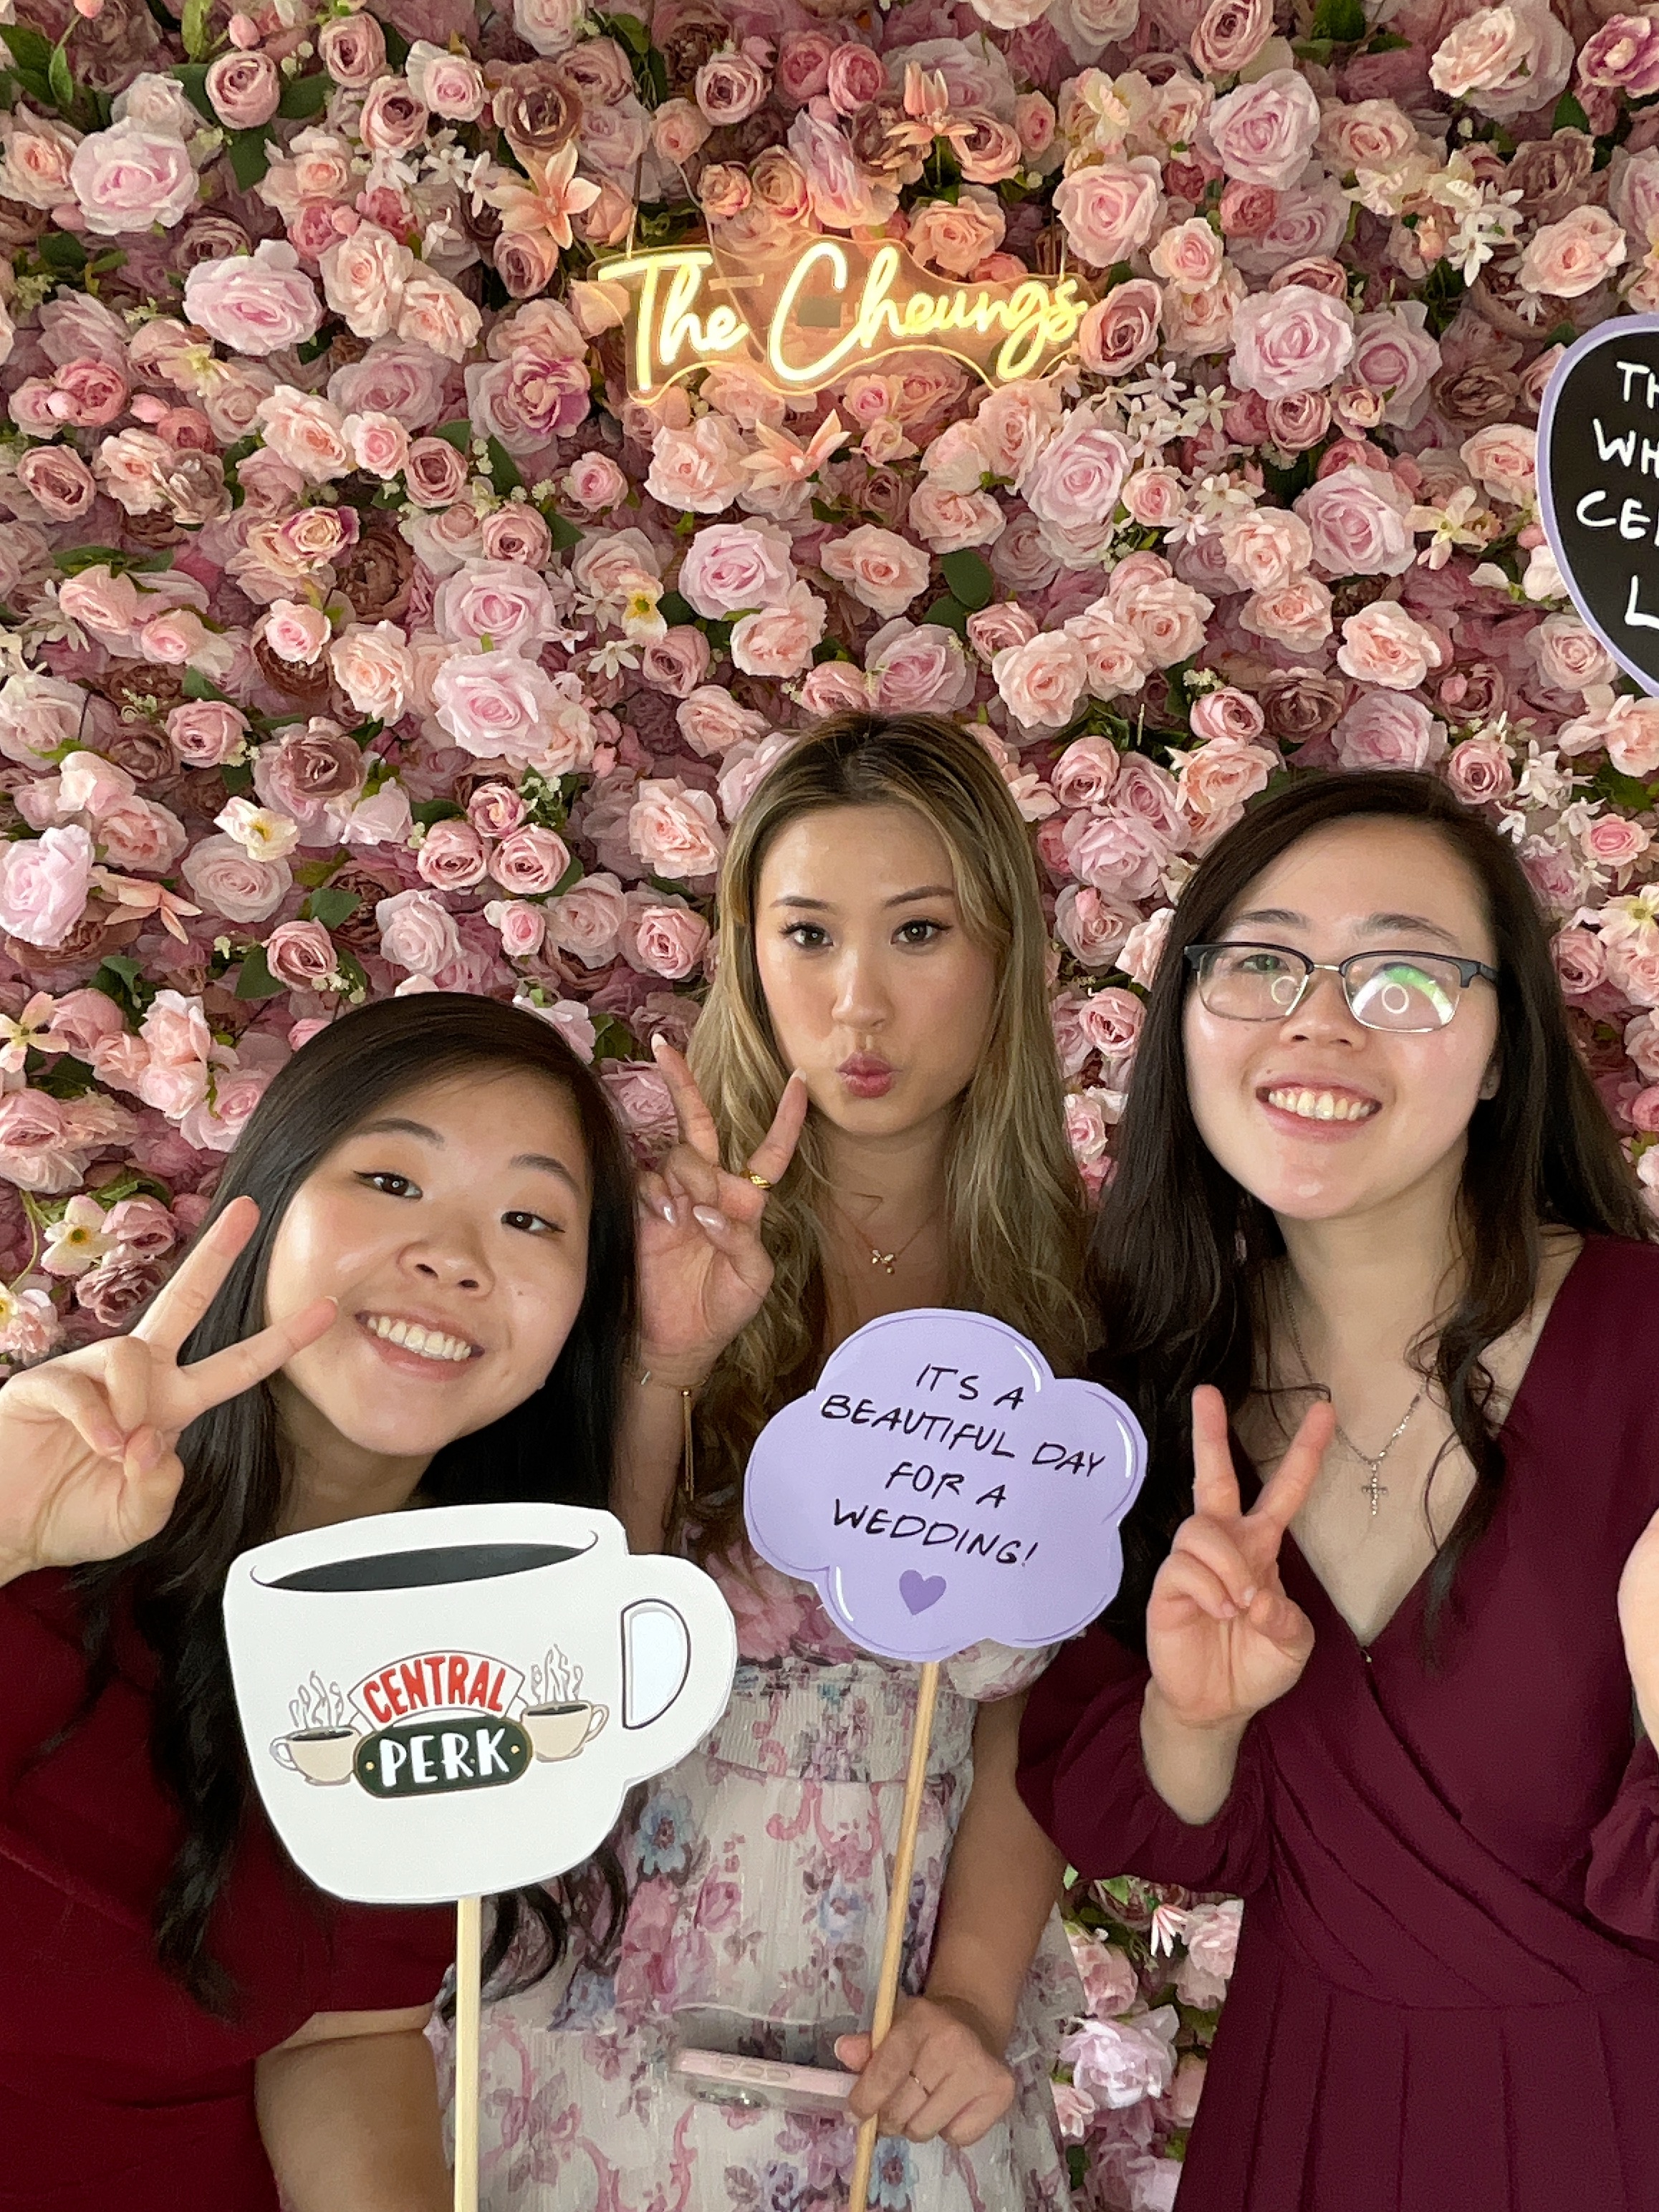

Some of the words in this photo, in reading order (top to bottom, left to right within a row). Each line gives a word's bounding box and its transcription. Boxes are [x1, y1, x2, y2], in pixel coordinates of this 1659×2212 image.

[597, 251, 749, 391] The
[768, 241, 1089, 382] Cheungs
[1576, 490, 1659, 547] CE
[993, 1387, 1024, 1410] A
[821, 1394, 1016, 1458] BEAUTIFUL
[1032, 1441, 1106, 1477] DAY
[885, 1461, 965, 1500] FOR
[975, 1484, 1006, 1509] A
[834, 1499, 1039, 1567] WEDDING!
[362, 1655, 506, 1723] CENTRAL
[378, 1727, 510, 1788] PERK
